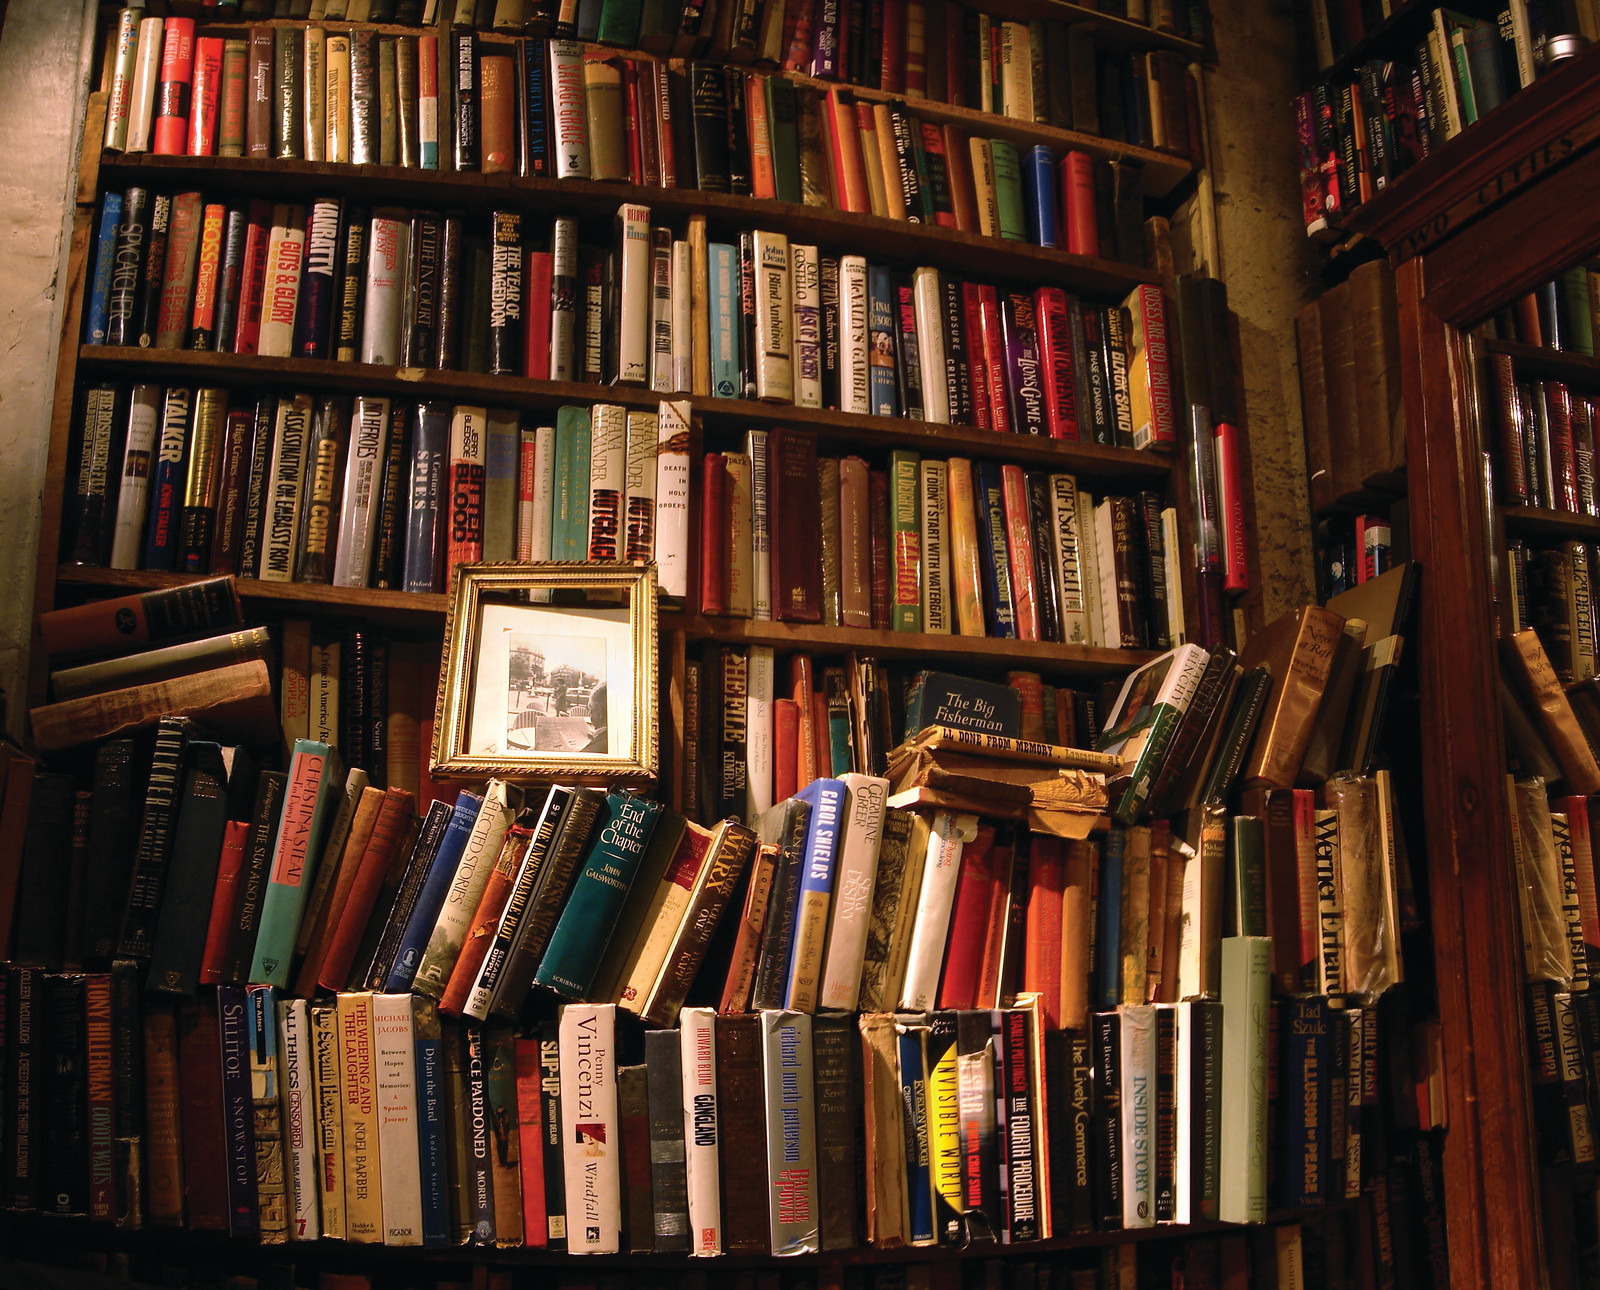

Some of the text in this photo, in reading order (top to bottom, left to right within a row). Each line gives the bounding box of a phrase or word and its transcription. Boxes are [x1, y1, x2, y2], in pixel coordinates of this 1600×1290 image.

[164, 29, 179, 66] CRICHTON
[178, 36, 190, 60] MICHAEL
[284, 46, 294, 82] TESTAMENT
[460, 36, 472, 46] THE
[460, 47, 472, 62] PRICE
[120, 81, 130, 118] THREE TO
[224, 58, 244, 138] THE MURDERERS
[254, 60, 270, 102] Masquerade
[282, 88, 293, 106] JOHN
[460, 70, 472, 90] HONOR
[558, 64, 582, 106] SAVAGE
[282, 108, 292, 141] GRISHAM
[460, 104, 468, 146] HACKWORTH
[528, 69, 544, 154] MORTAL FEAR
[560, 110, 585, 146] GRACE
[1478, 134, 1574, 204] CITIES
[200, 218, 222, 262] BOSS
[110, 223, 143, 320] SPYCATCHER
[196, 262, 214, 308] Chicago
[272, 242, 300, 326] GUTS & GLORY
[490, 244, 508, 328] ARMAGEDDON
[506, 246, 522, 320] THE YEAR OF
[794, 248, 807, 300] COSTELLO
[806, 262, 818, 290] JOHN
[340, 276, 358, 340] FAMILY SPIRITS
[586, 286, 602, 373] THE FOURTH MAN
[768, 273, 783, 350] Blind Ambition
[947, 284, 960, 350] DISCLOSURE
[1107, 307, 1118, 348] CAUNITZ
[850, 277, 867, 403] McNALLY'S GAMBLE
[1050, 311, 1076, 422] AIRMAN CARPENTER
[1144, 288, 1174, 434] ROSES ARE RED PATTERSON
[946, 358, 959, 416] CRICHTON
[960, 362, 970, 414] MICHAEL
[1110, 351, 1132, 432] BLACK SAND
[158, 388, 190, 463] STALKER
[356, 402, 383, 460] NO HEROES
[462, 415, 472, 458] BLEDSOE
[470, 430, 478, 459] JERRY
[592, 412, 609, 482] ALEXANDER
[607, 410, 624, 452] SHANA
[628, 420, 644, 490] ALEXANDER
[643, 418, 658, 460] SHANA
[268, 410, 306, 573] ASSASSINATION ON EMBASSY ROW
[306, 439, 337, 553] CITIZEN COHN
[414, 450, 430, 510] SPIES
[452, 464, 469, 543] BLOOD
[466, 464, 484, 543] BITTER
[658, 502, 688, 510] ORDERS
[898, 461, 916, 524] LEN DEIGHTON
[926, 468, 942, 629] IT DIDN'T START WITH WATERGATE
[988, 488, 1011, 603] The Canfield Decision
[1234, 499, 1245, 568] ATONEMENT
[946, 692, 996, 719] The Big
[1170, 651, 1198, 705] BINCHY
[1176, 660, 1206, 708] MAEVE
[934, 704, 1004, 733] Fisherman
[723, 750, 735, 800] KIMBALL
[734, 760, 746, 790] PENN
[286, 757, 323, 886] CHRISTINA STEAD
[609, 819, 644, 839] of the
[618, 804, 645, 824] End
[810, 790, 838, 880] CAROL SHIELDS
[854, 786, 872, 828] GREER
[863, 784, 884, 846] GERMAINE
[448, 793, 500, 906] SELECTED STORIES
[598, 828, 644, 854] Chapter
[600, 863, 621, 878] JOHN
[704, 828, 743, 894] MARX
[722, 836, 754, 898] ELEANOR
[240, 823, 270, 930] THE SUN ALSO RISES
[498, 820, 555, 942] THE UNRESOLVABLE PLOT
[1314, 814, 1345, 999] Werner Erhard
[483, 948, 500, 978] DIPPLE
[674, 952, 692, 981] KAPP
[223, 1004, 243, 1080] SILLITOE
[286, 1006, 299, 1089] ALL THINGS
[345, 1012, 358, 1106] THE LAUGHTER
[356, 1001, 372, 1114] THE WEEPING AND
[578, 1015, 599, 1120] Vincenzi
[592, 1048, 606, 1086] Penny
[696, 1028, 712, 1086] HOWARD BLUM
[86, 980, 112, 1186] TONY HILLERMAN COYOTE WAITS
[780, 1026, 802, 1163] richard north patterson
[1071, 1038, 1090, 1186] The Lively Commerce
[232, 1096, 248, 1186] SNOWSTOP
[290, 1092, 302, 1147] CENSORED
[694, 1094, 716, 1146] GANGLAND
[938, 1058, 962, 1200] INVISIBLE WORLD
[1134, 1076, 1150, 1193] INSIDE STORY
[354, 1122, 368, 1200] NOEL BARBER
[1010, 1097, 1035, 1223] THE FOURTH PROCEDURE
[583, 1162, 598, 1221] Windfall
